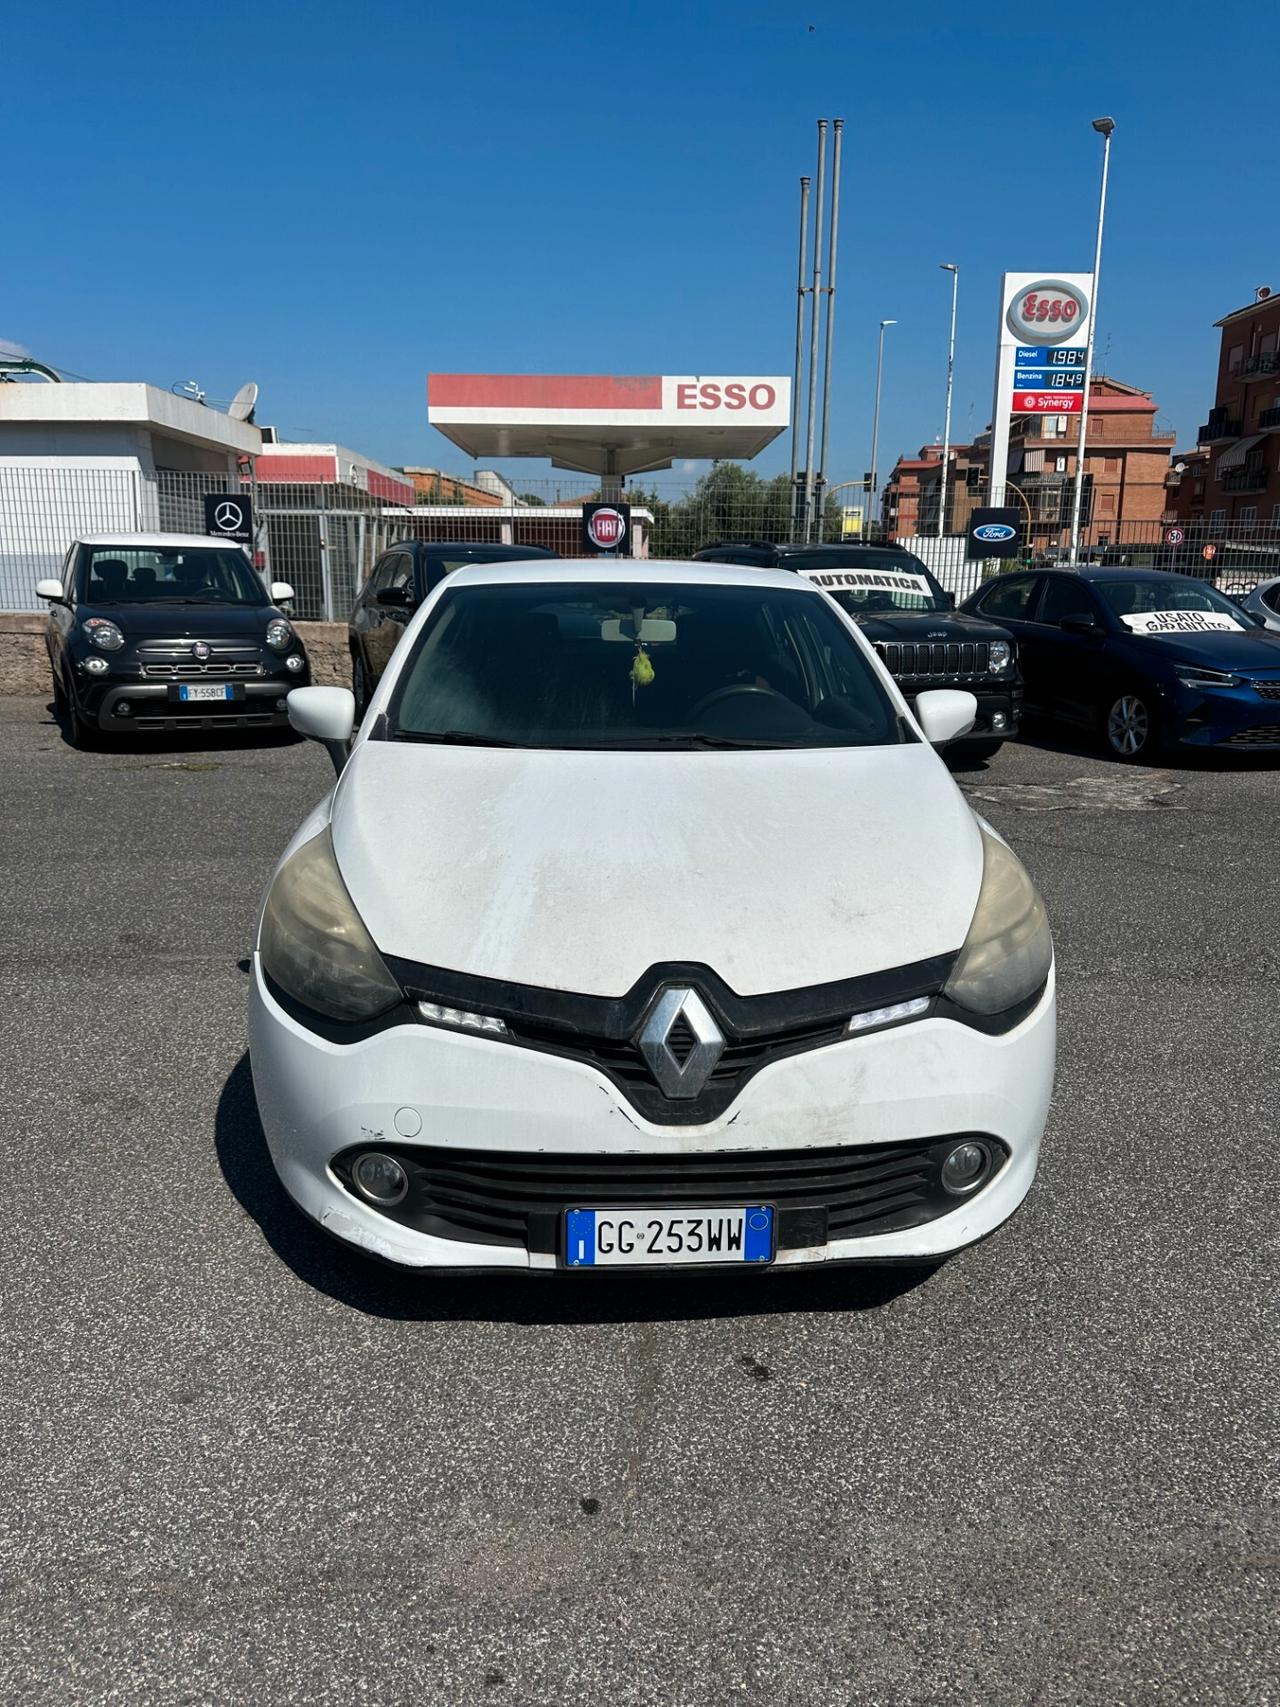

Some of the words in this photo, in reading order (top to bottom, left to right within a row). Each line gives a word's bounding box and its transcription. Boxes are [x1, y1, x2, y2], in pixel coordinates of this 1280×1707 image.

[1018, 350, 1038, 358] Diesel
[1016, 372, 1043, 380] Benzina
[677, 384, 776, 410] ESSO
[1038, 397, 1074, 409] Synergy
[597, 520, 618, 537] FIAT
[982, 527, 1006, 538] Ford
[1154, 612, 1205, 623] USATO
